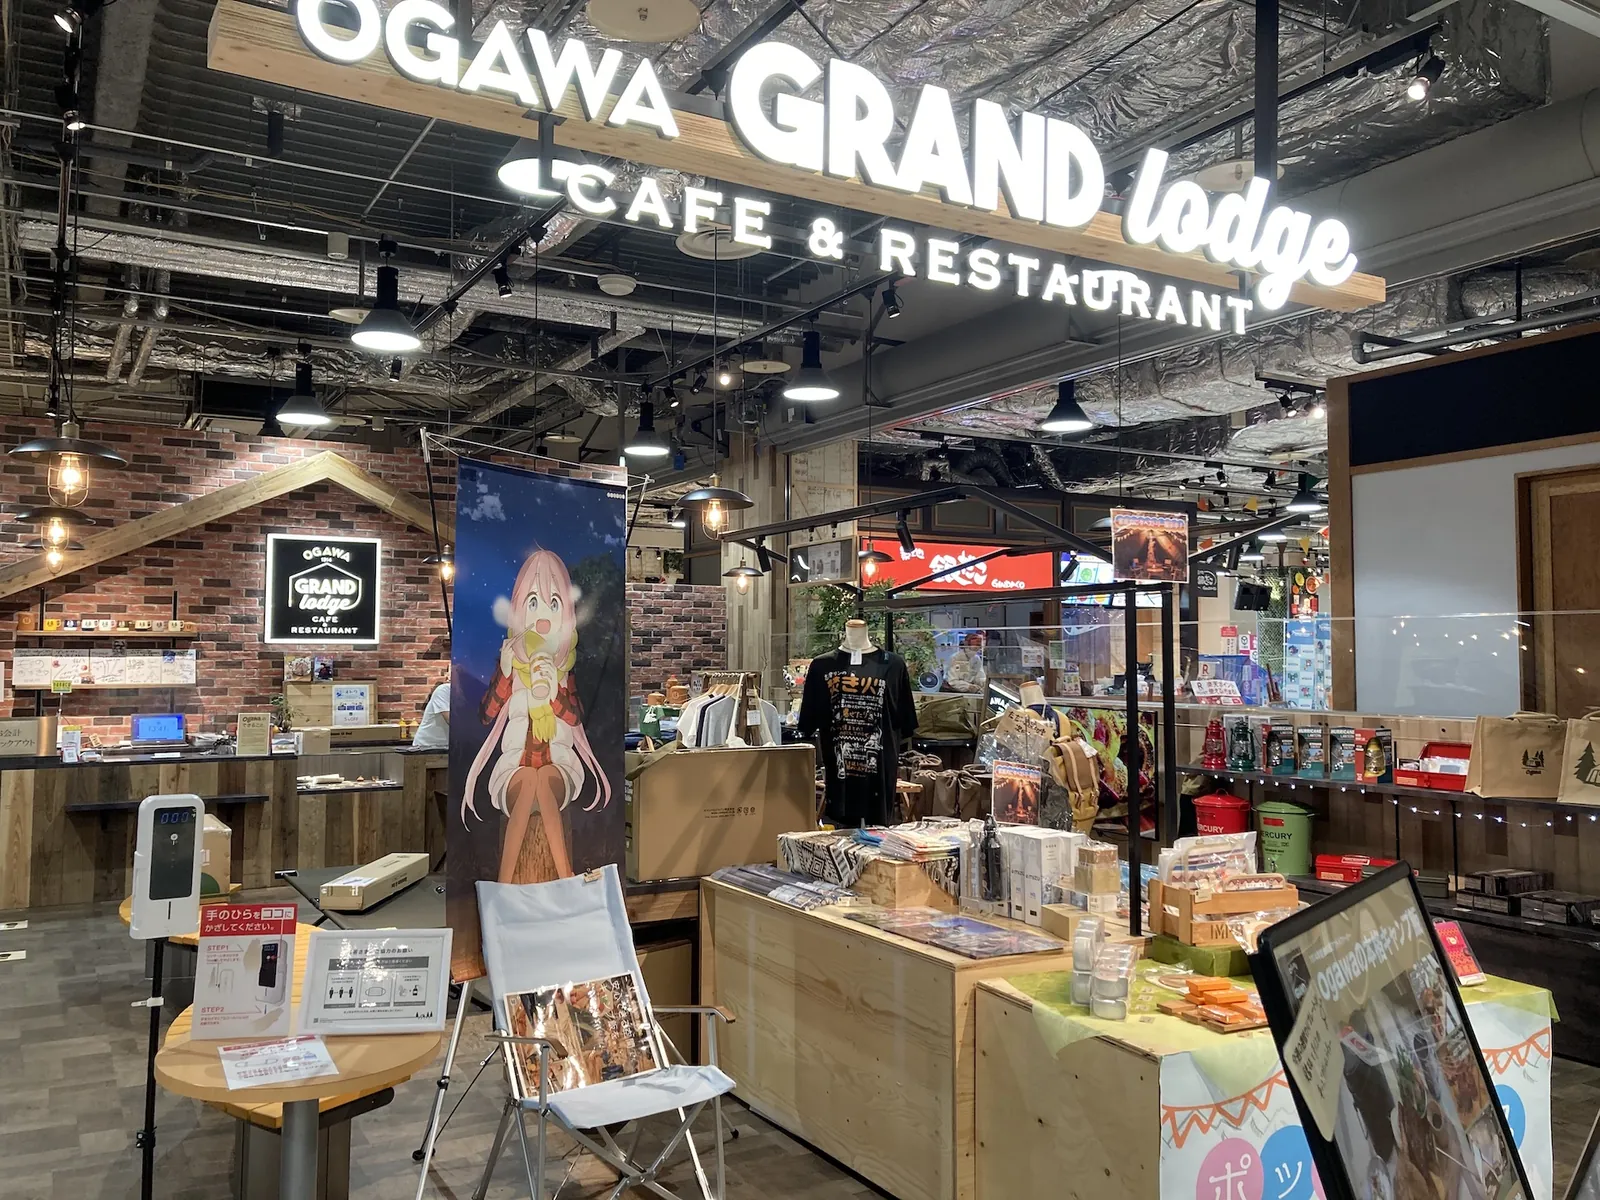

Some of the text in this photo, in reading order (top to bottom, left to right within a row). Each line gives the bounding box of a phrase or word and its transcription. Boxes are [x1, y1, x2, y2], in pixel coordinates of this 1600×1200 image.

[295, 0, 681, 139] OGAWA
[727, 42, 1357, 311] GRAND lodge
[566, 164, 1254, 335] CAFE & RESTAURANT
[302, 546, 351, 563] OGAWA
[294, 578, 357, 595] GRAND
[298, 594, 352, 616] lodge
[290, 626, 359, 635] RESTAURANT
[1197, 823, 1224, 833] ERCURY
[1262, 830, 1293, 840] ERCURY
[206, 907, 293, 921] 手のひらをココに
[204, 922, 275, 933] かざしてください。
